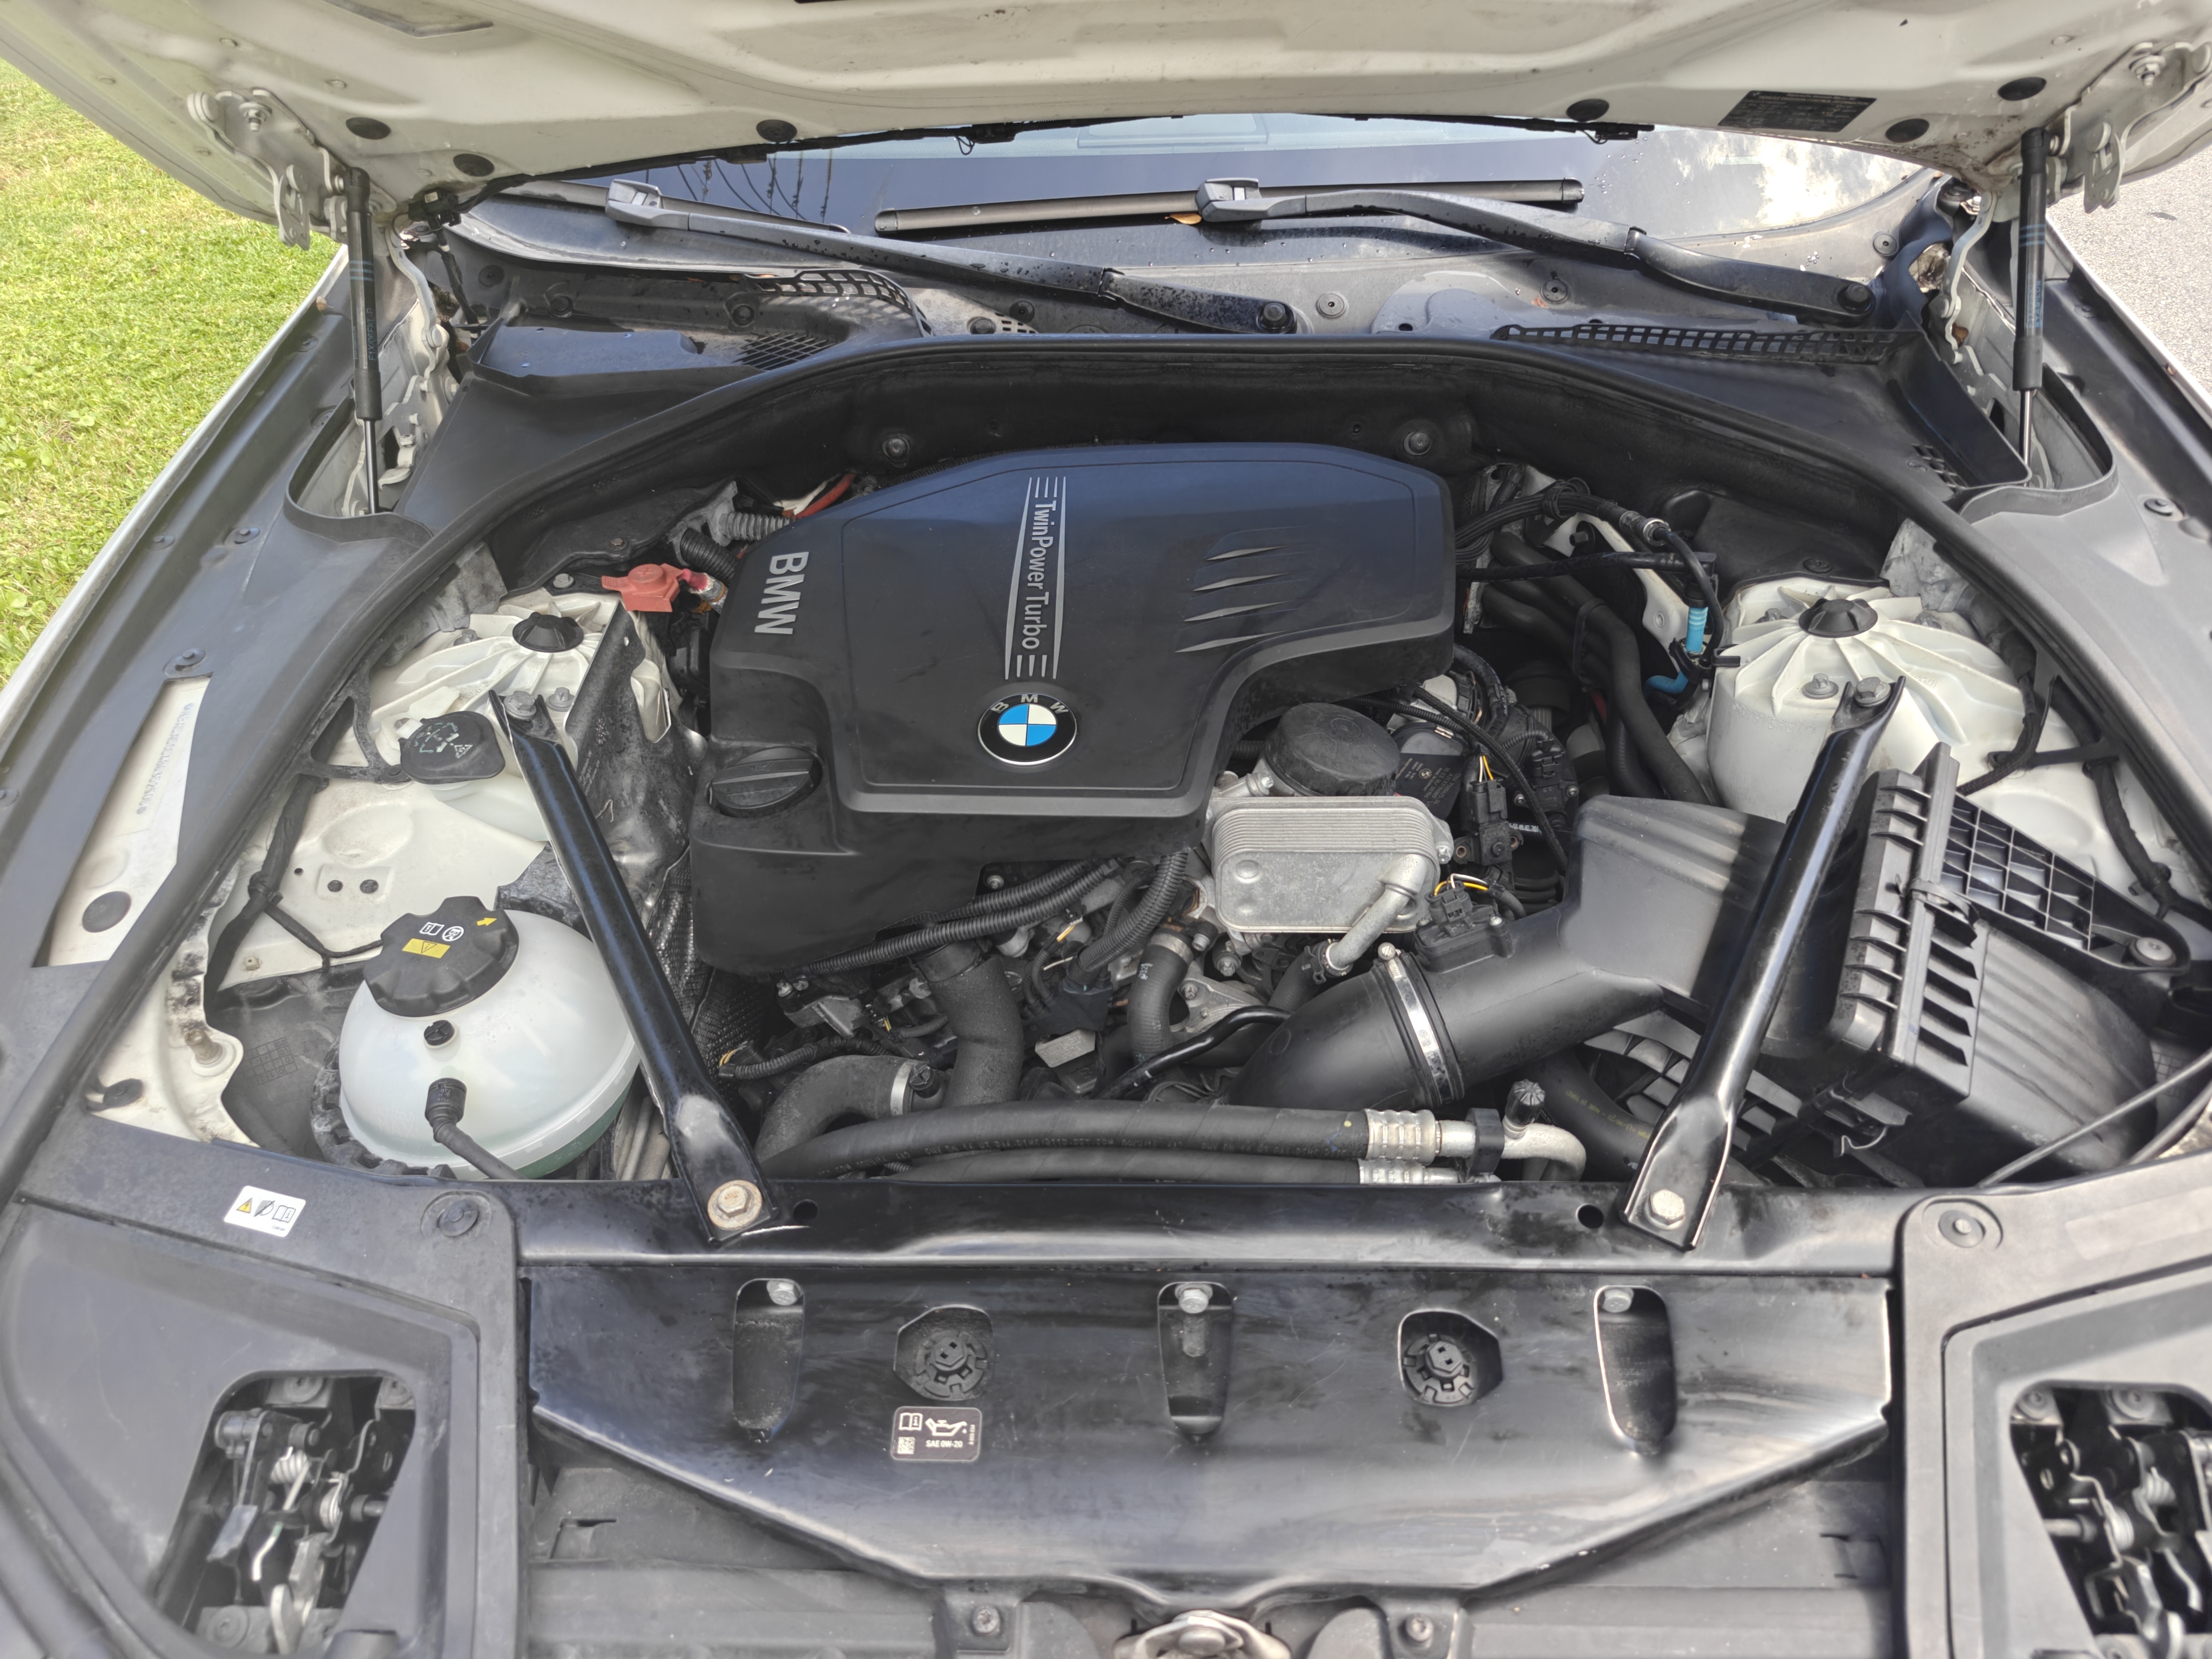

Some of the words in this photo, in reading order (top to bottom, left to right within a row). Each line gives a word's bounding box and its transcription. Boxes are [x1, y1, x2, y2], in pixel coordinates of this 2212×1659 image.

[1027, 500, 1056, 589] TwinPower
[754, 551, 809, 635] BMW
[1022, 592, 1049, 649] Turbo
[990, 693, 1069, 714] BMW
